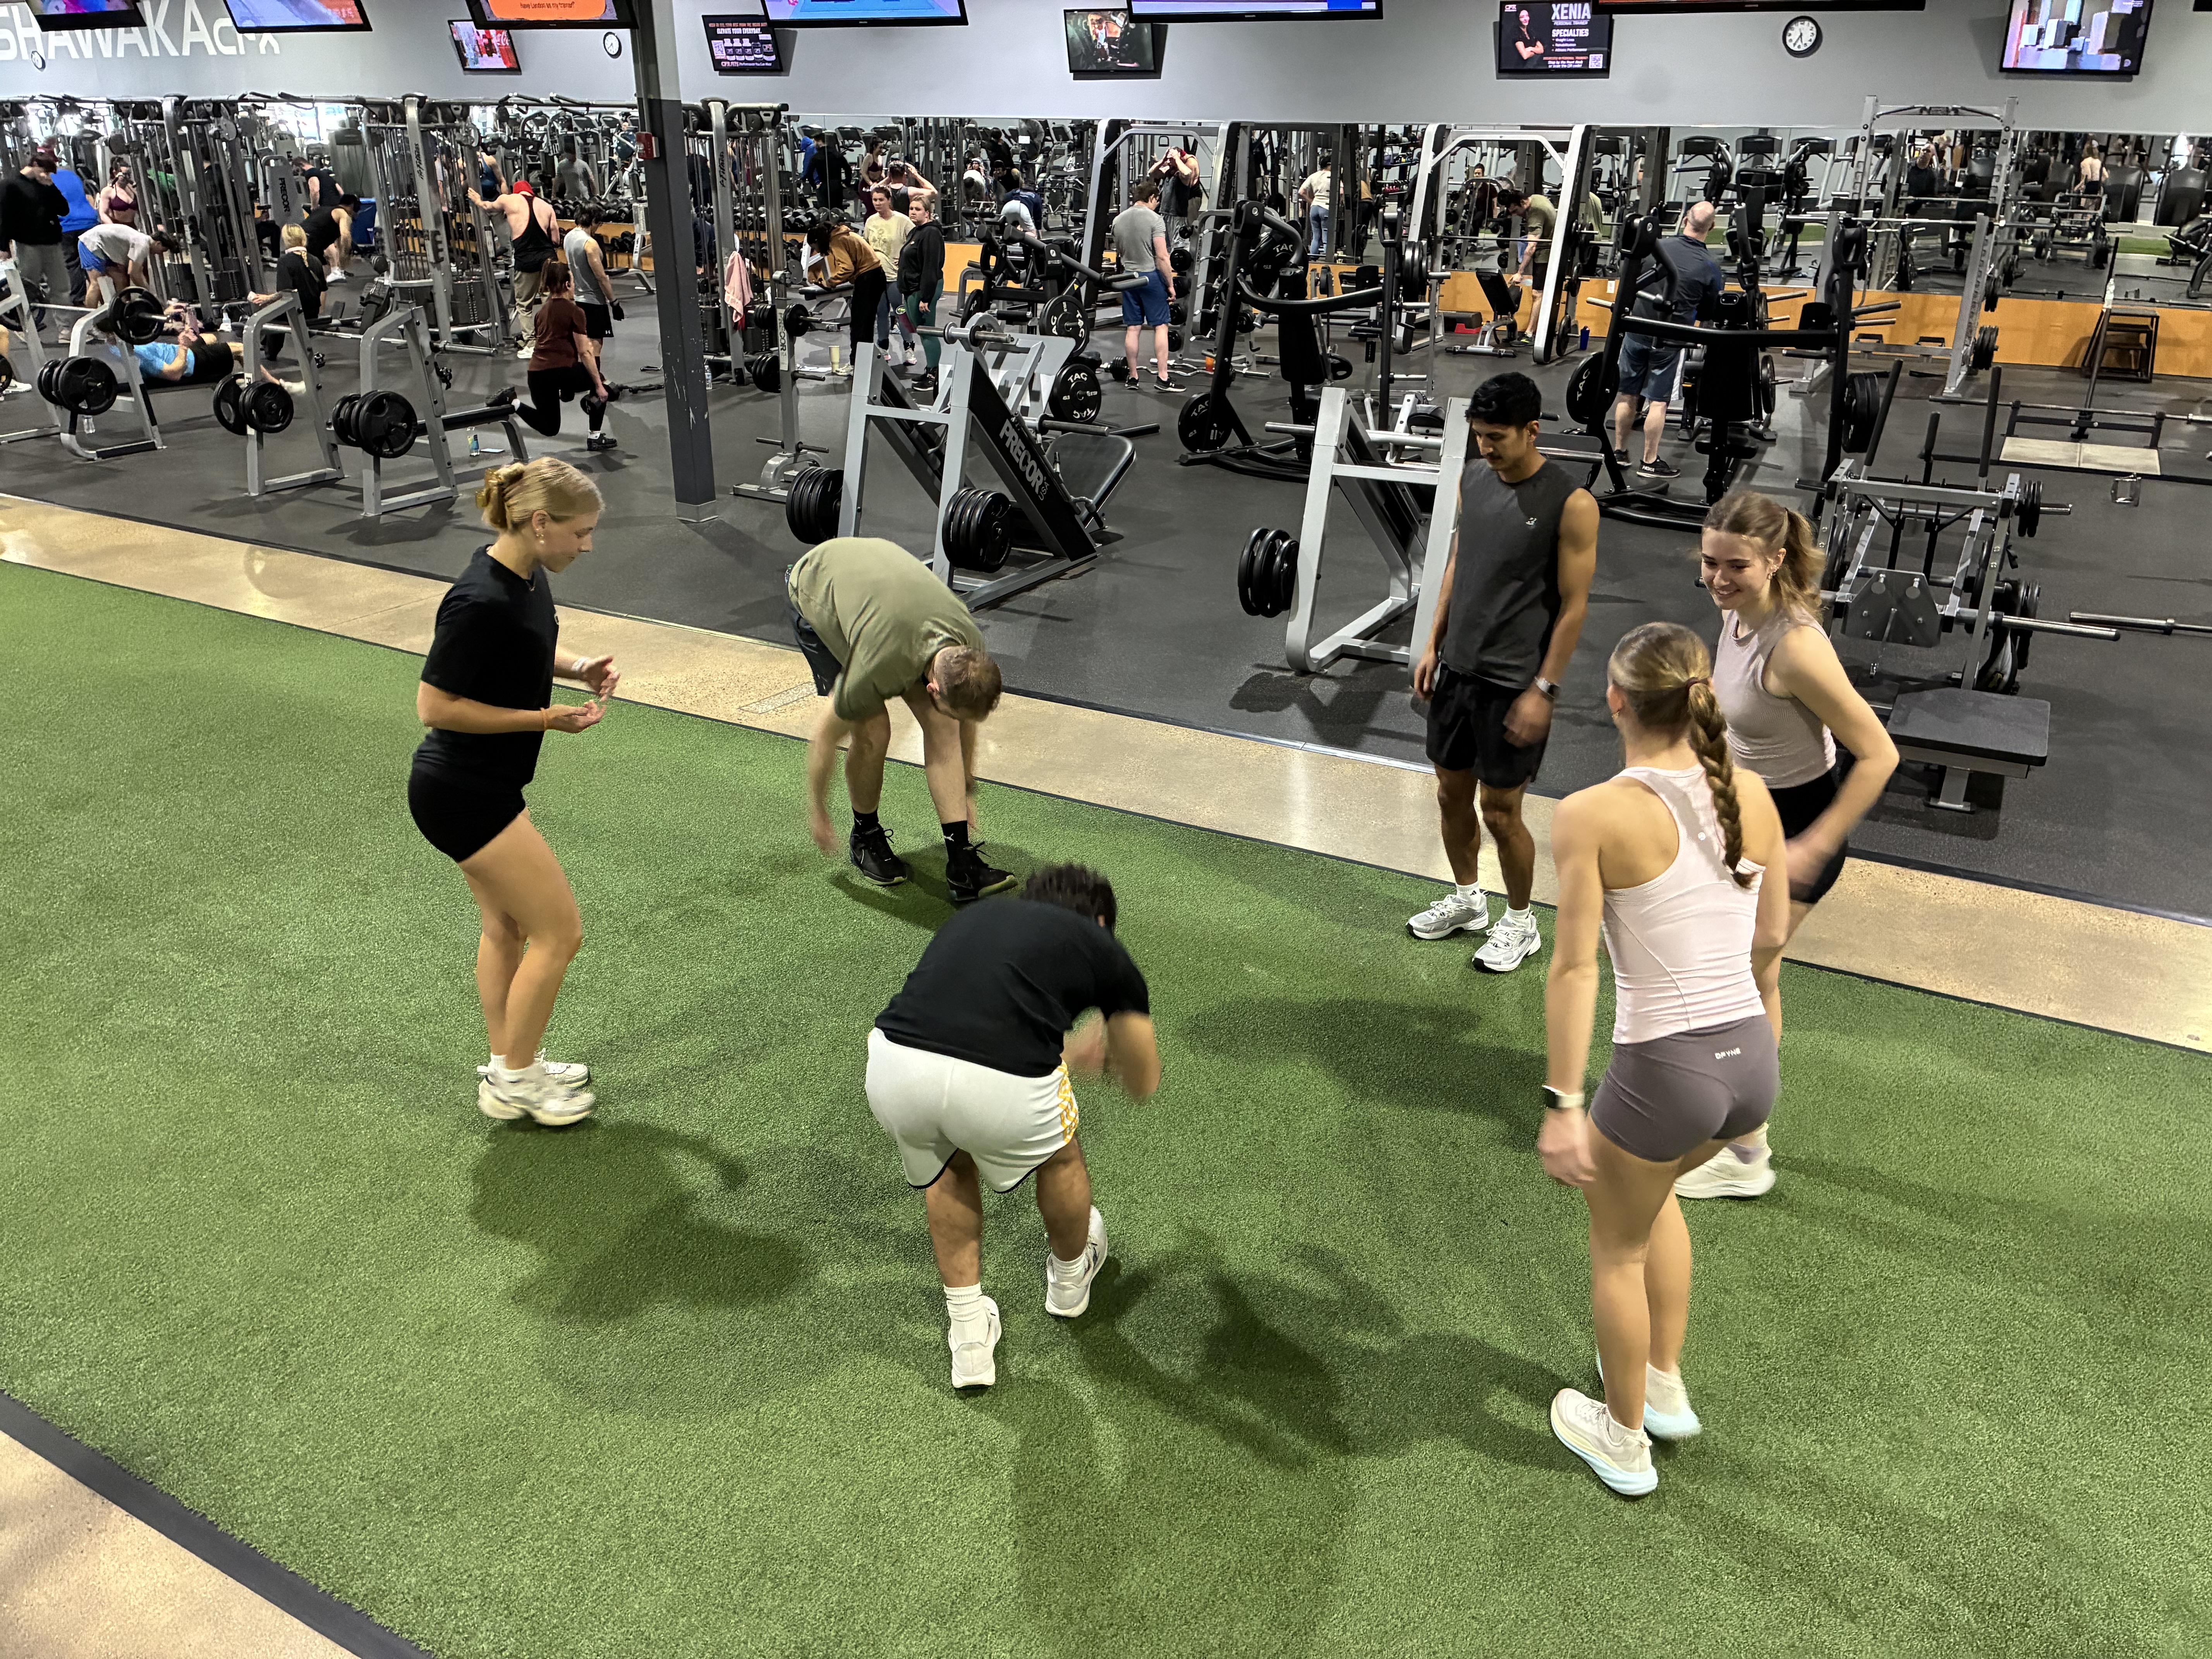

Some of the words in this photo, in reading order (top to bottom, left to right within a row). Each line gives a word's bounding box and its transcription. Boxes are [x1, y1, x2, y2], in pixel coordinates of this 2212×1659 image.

[1551, 3, 1591, 20] XENIA
[1552, 29, 1589, 37] SPECIALTIES
[279, 177, 290, 212] PRECOR
[1218, 156, 1230, 208] PRECOR
[1076, 310, 1085, 338] TAG
[1067, 372, 1088, 383] TAG
[1577, 368, 1590, 401] TAG
[1073, 408, 1093, 419] TAG
[999, 418, 1043, 495] PRECOR
[1038, 479, 1050, 501] USA
